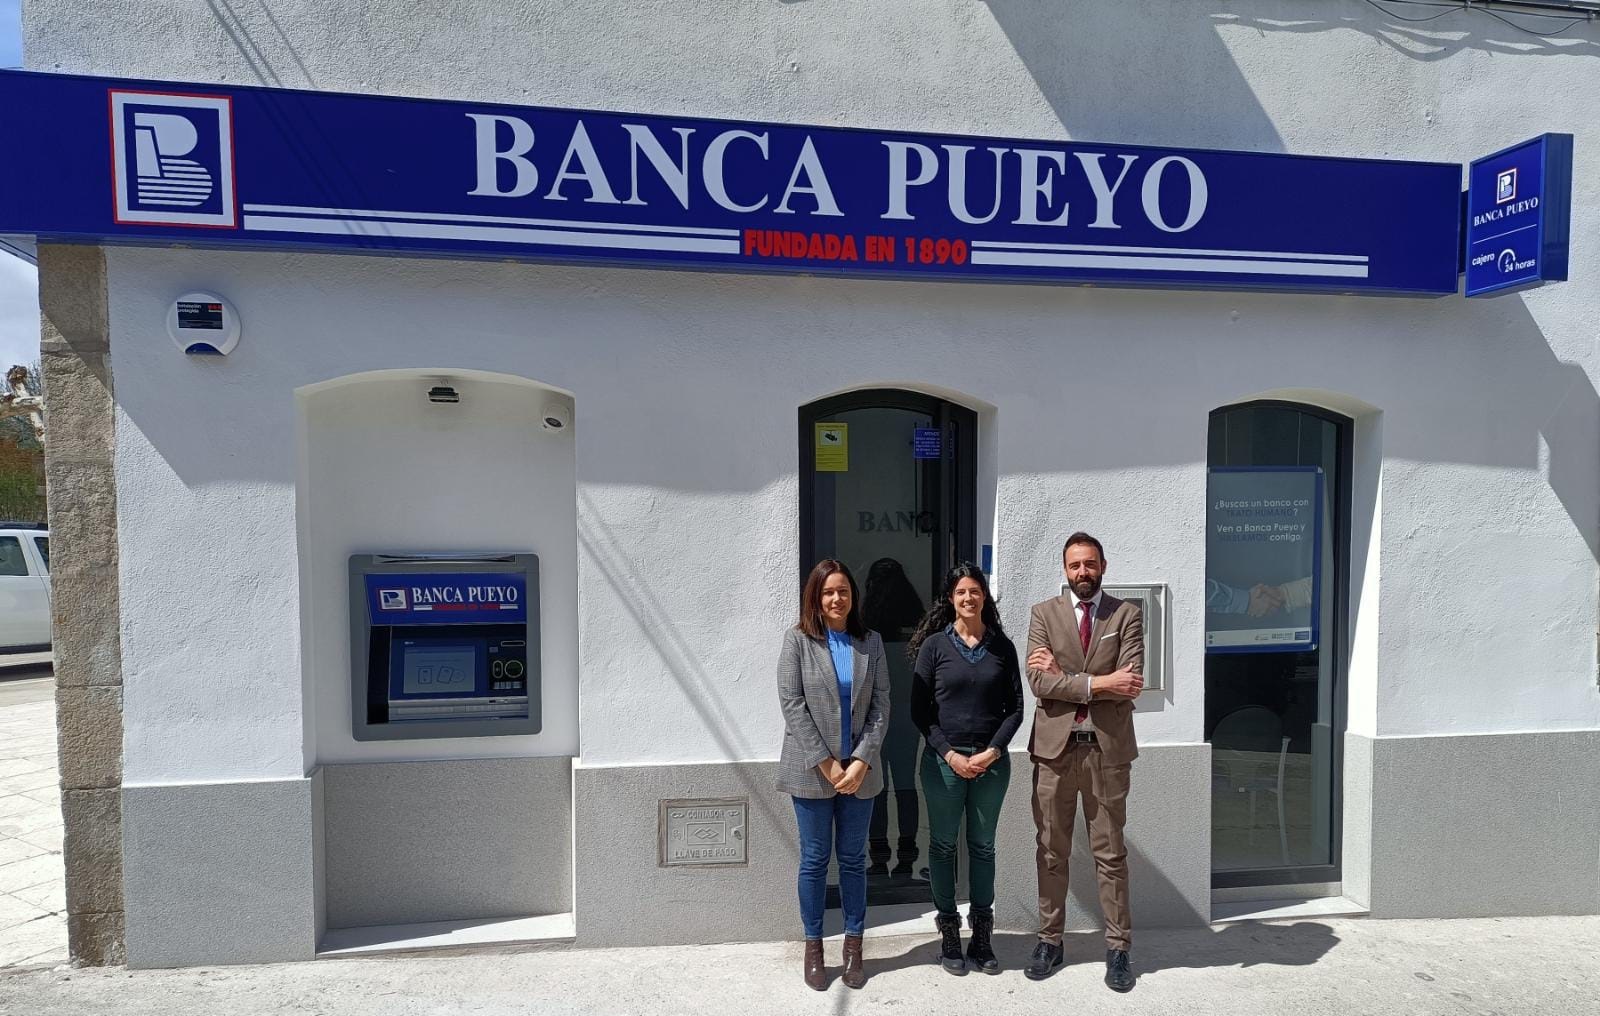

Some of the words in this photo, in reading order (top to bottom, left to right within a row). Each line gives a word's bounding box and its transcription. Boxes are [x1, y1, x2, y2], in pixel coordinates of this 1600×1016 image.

[466, 113, 845, 217] BANCA
[880, 140, 1208, 233] PUEYO
[1473, 209, 1503, 226] BANCA
[1506, 197, 1538, 216] PUEYO
[744, 229, 858, 262] FUNDADA
[865, 235, 895, 262] EN
[905, 237, 967, 264] 1890
[1472, 253, 1495, 266] cajero
[1505, 262, 1513, 272] 24
[1515, 259, 1536, 270] horas
[1264, 498, 1291, 508] banco
[1293, 498, 1309, 507] con
[1216, 524, 1234, 534] Ven
[1244, 524, 1272, 533] Banca
[1274, 522, 1298, 533] Pueyo
[1300, 523, 1306, 533] y
[412, 586, 464, 603] BANCA
[467, 586, 518, 602] PUEYO
[675, 848, 700, 859] LLAVE
[702, 848, 713, 858] DE
